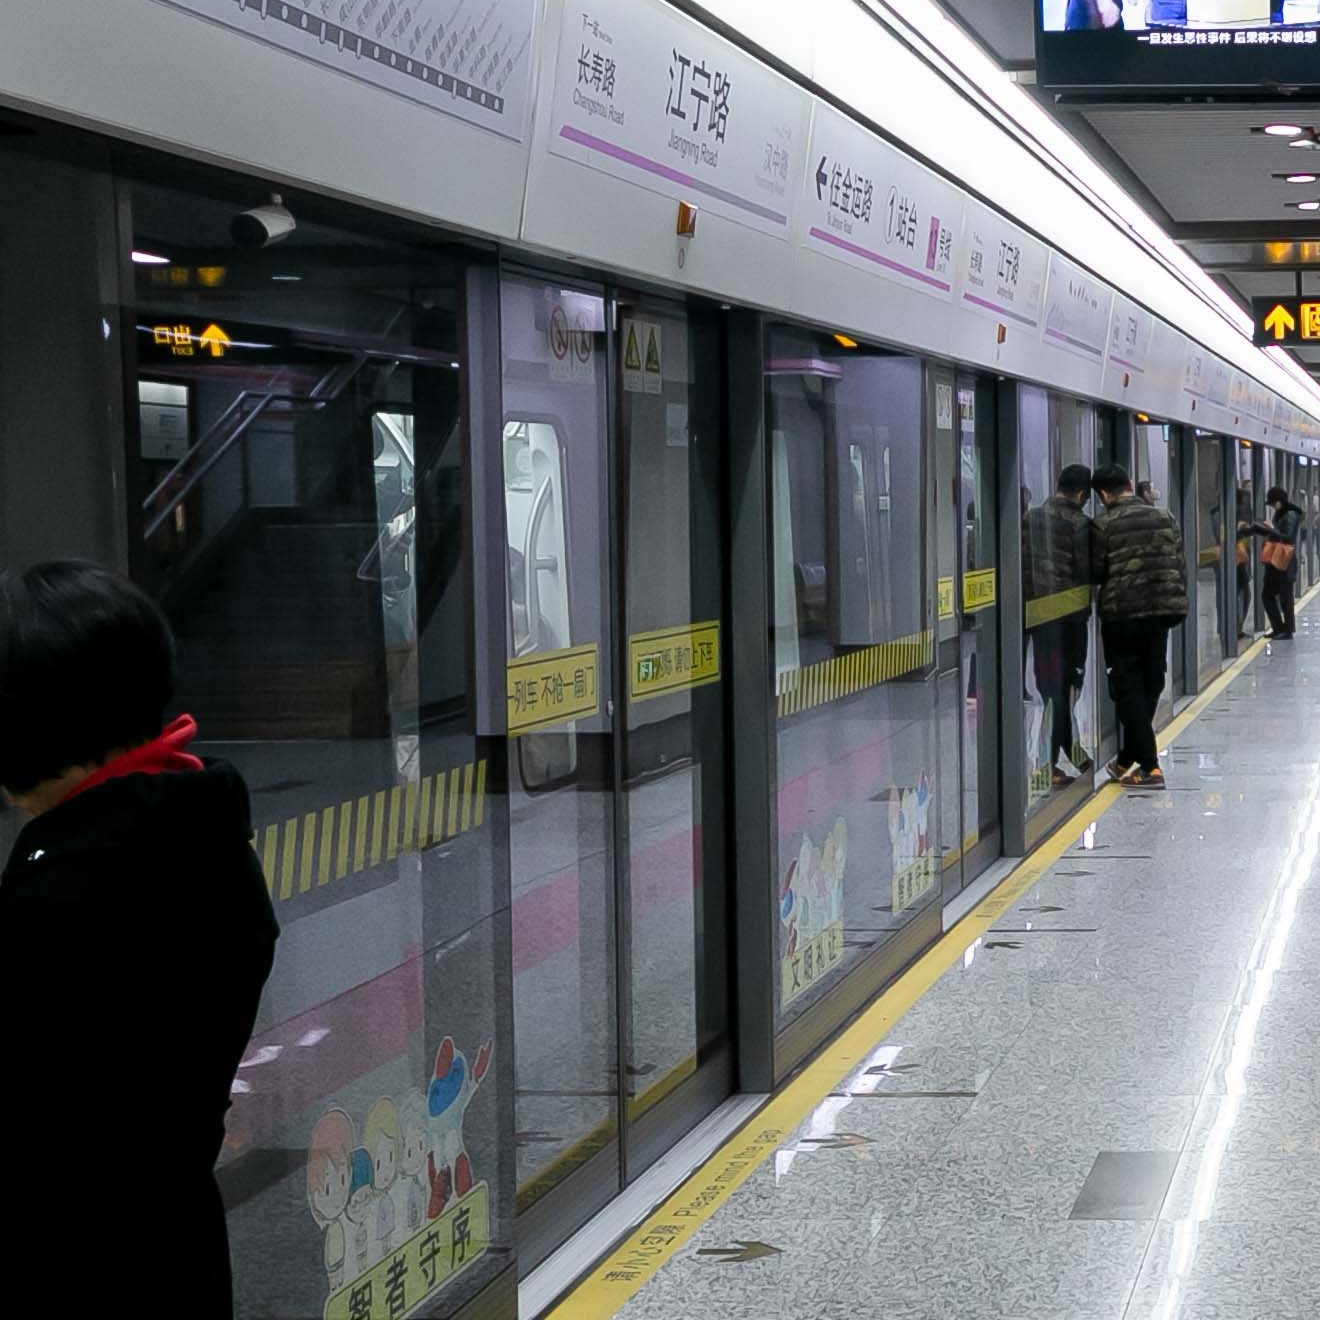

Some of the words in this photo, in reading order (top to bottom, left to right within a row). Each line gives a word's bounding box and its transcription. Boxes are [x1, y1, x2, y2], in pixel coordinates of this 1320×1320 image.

[577, 43, 616, 100] 长寿路
[608, 104, 625, 126] Road
[665, 47, 731, 144] 江宁路
[700, 141, 719, 168] Road
[829, 161, 873, 224] 往金运路
[896, 196, 918, 249] 站台
[672, 1184, 726, 1218] Please
